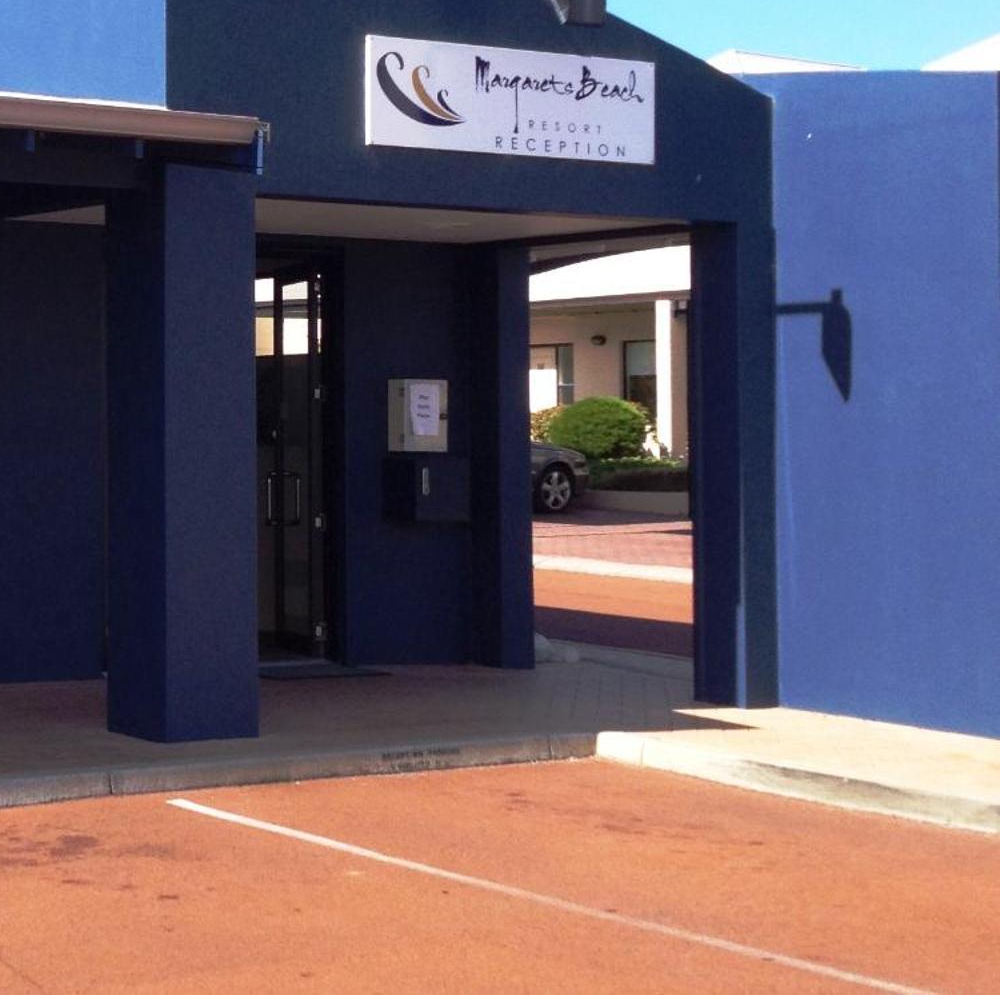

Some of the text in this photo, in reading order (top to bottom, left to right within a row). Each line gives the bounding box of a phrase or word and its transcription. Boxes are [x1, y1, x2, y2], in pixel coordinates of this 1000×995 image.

[475, 56, 644, 134] Margarets Beach
[528, 119, 602, 135] RESORT
[495, 136, 626, 157] RECEPTION
